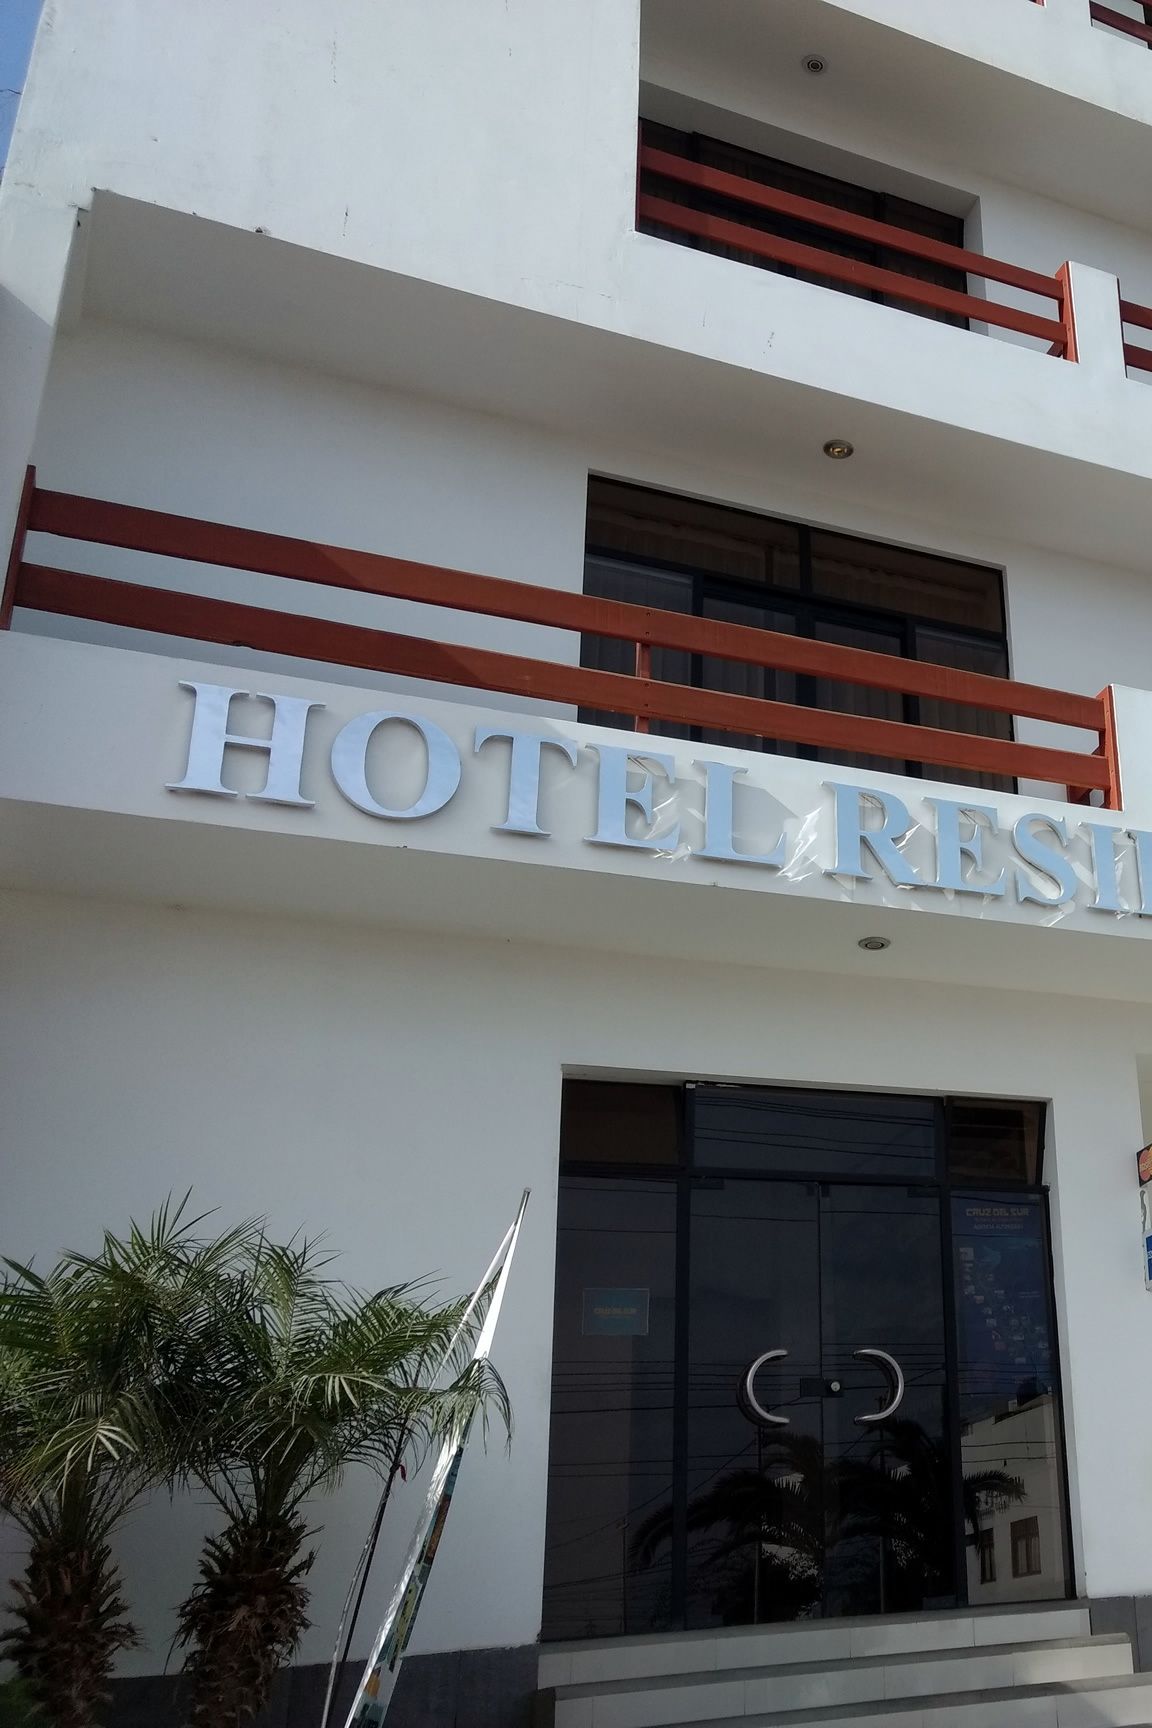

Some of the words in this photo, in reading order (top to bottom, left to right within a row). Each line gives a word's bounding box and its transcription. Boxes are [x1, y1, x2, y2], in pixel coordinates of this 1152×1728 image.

[164, 680, 789, 869] HOTEL
[966, 1207, 991, 1216] CRUZ
[1010, 1207, 1029, 1216] SUR
